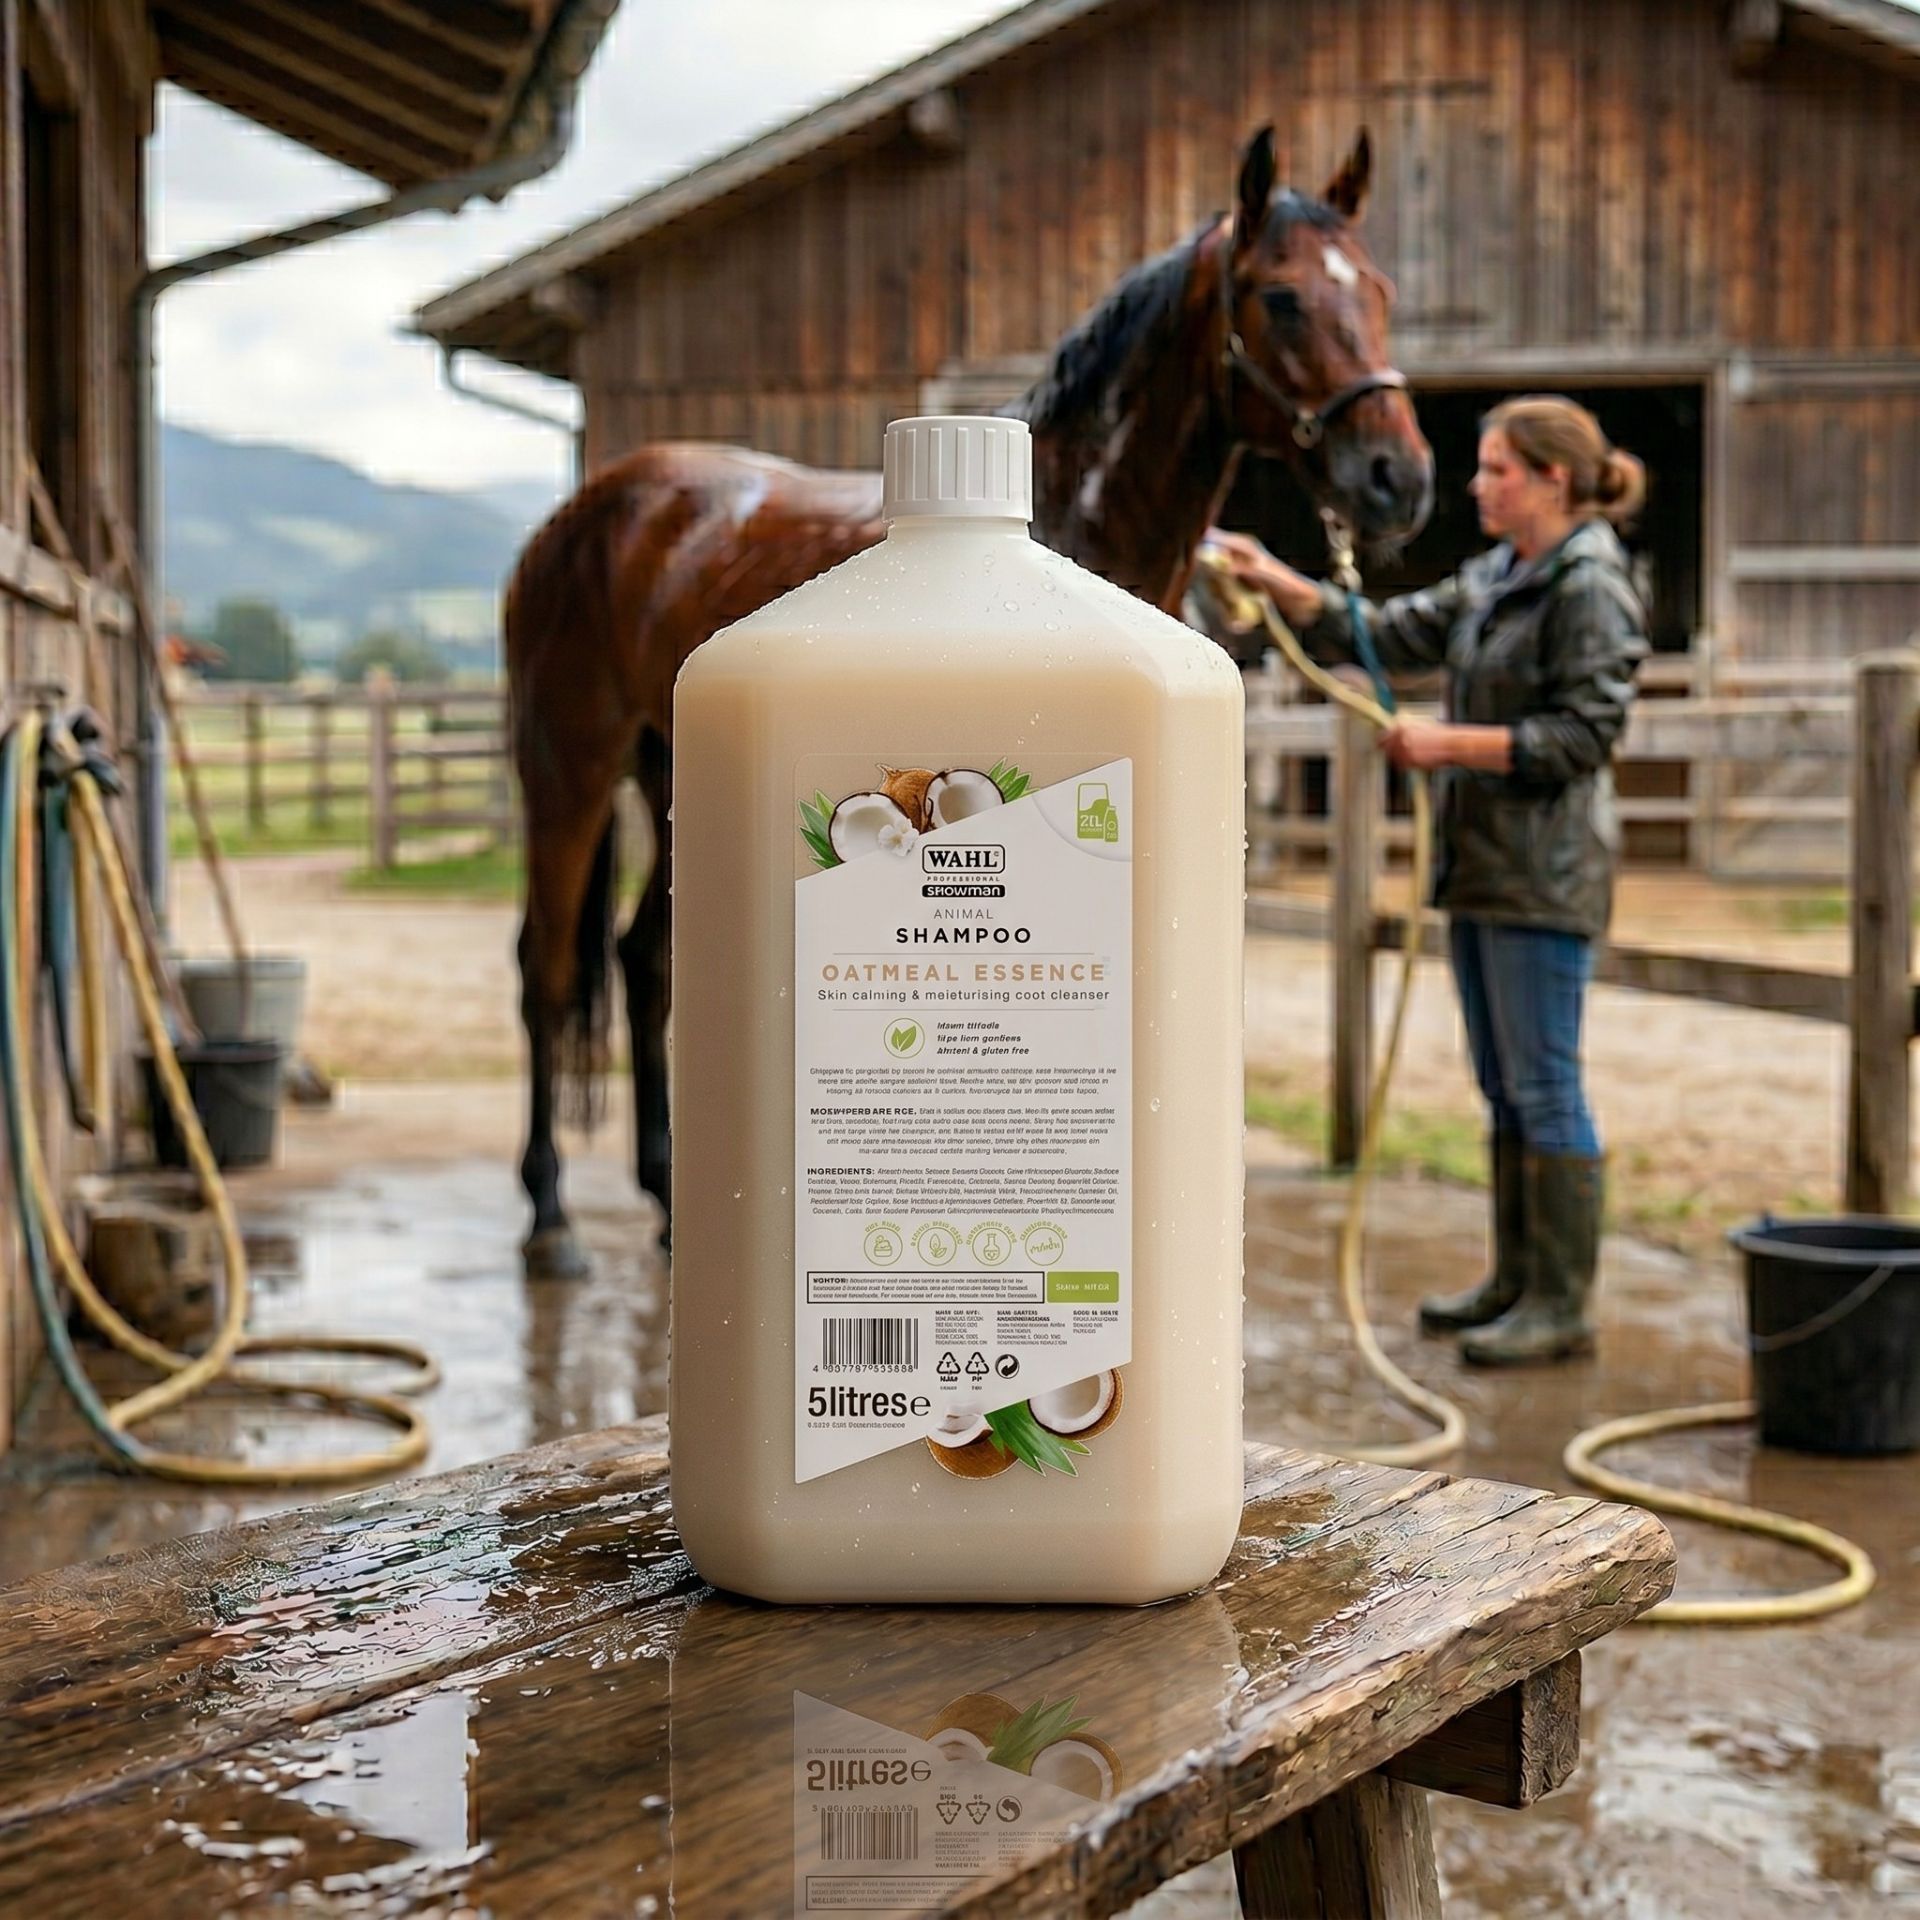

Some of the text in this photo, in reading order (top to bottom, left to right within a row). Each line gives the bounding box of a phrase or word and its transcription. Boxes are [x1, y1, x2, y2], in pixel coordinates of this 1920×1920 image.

[927, 850, 998, 868] WAHL
[933, 909, 994, 920] ANIMAL
[895, 927, 1032, 944] SHAMPOO
[821, 964, 1105, 982] OATMEAL ESSENCE
[817, 989, 848, 1001] Skin
[911, 989, 920, 1001] &
[1050, 988, 1110, 1001] cleanser
[982, 1046, 1009, 1056] gluten
[1011, 1046, 1030, 1054] free
[807, 1167, 875, 1175] INGREDIENTS:
[807, 1386, 908, 1417] 5litres
